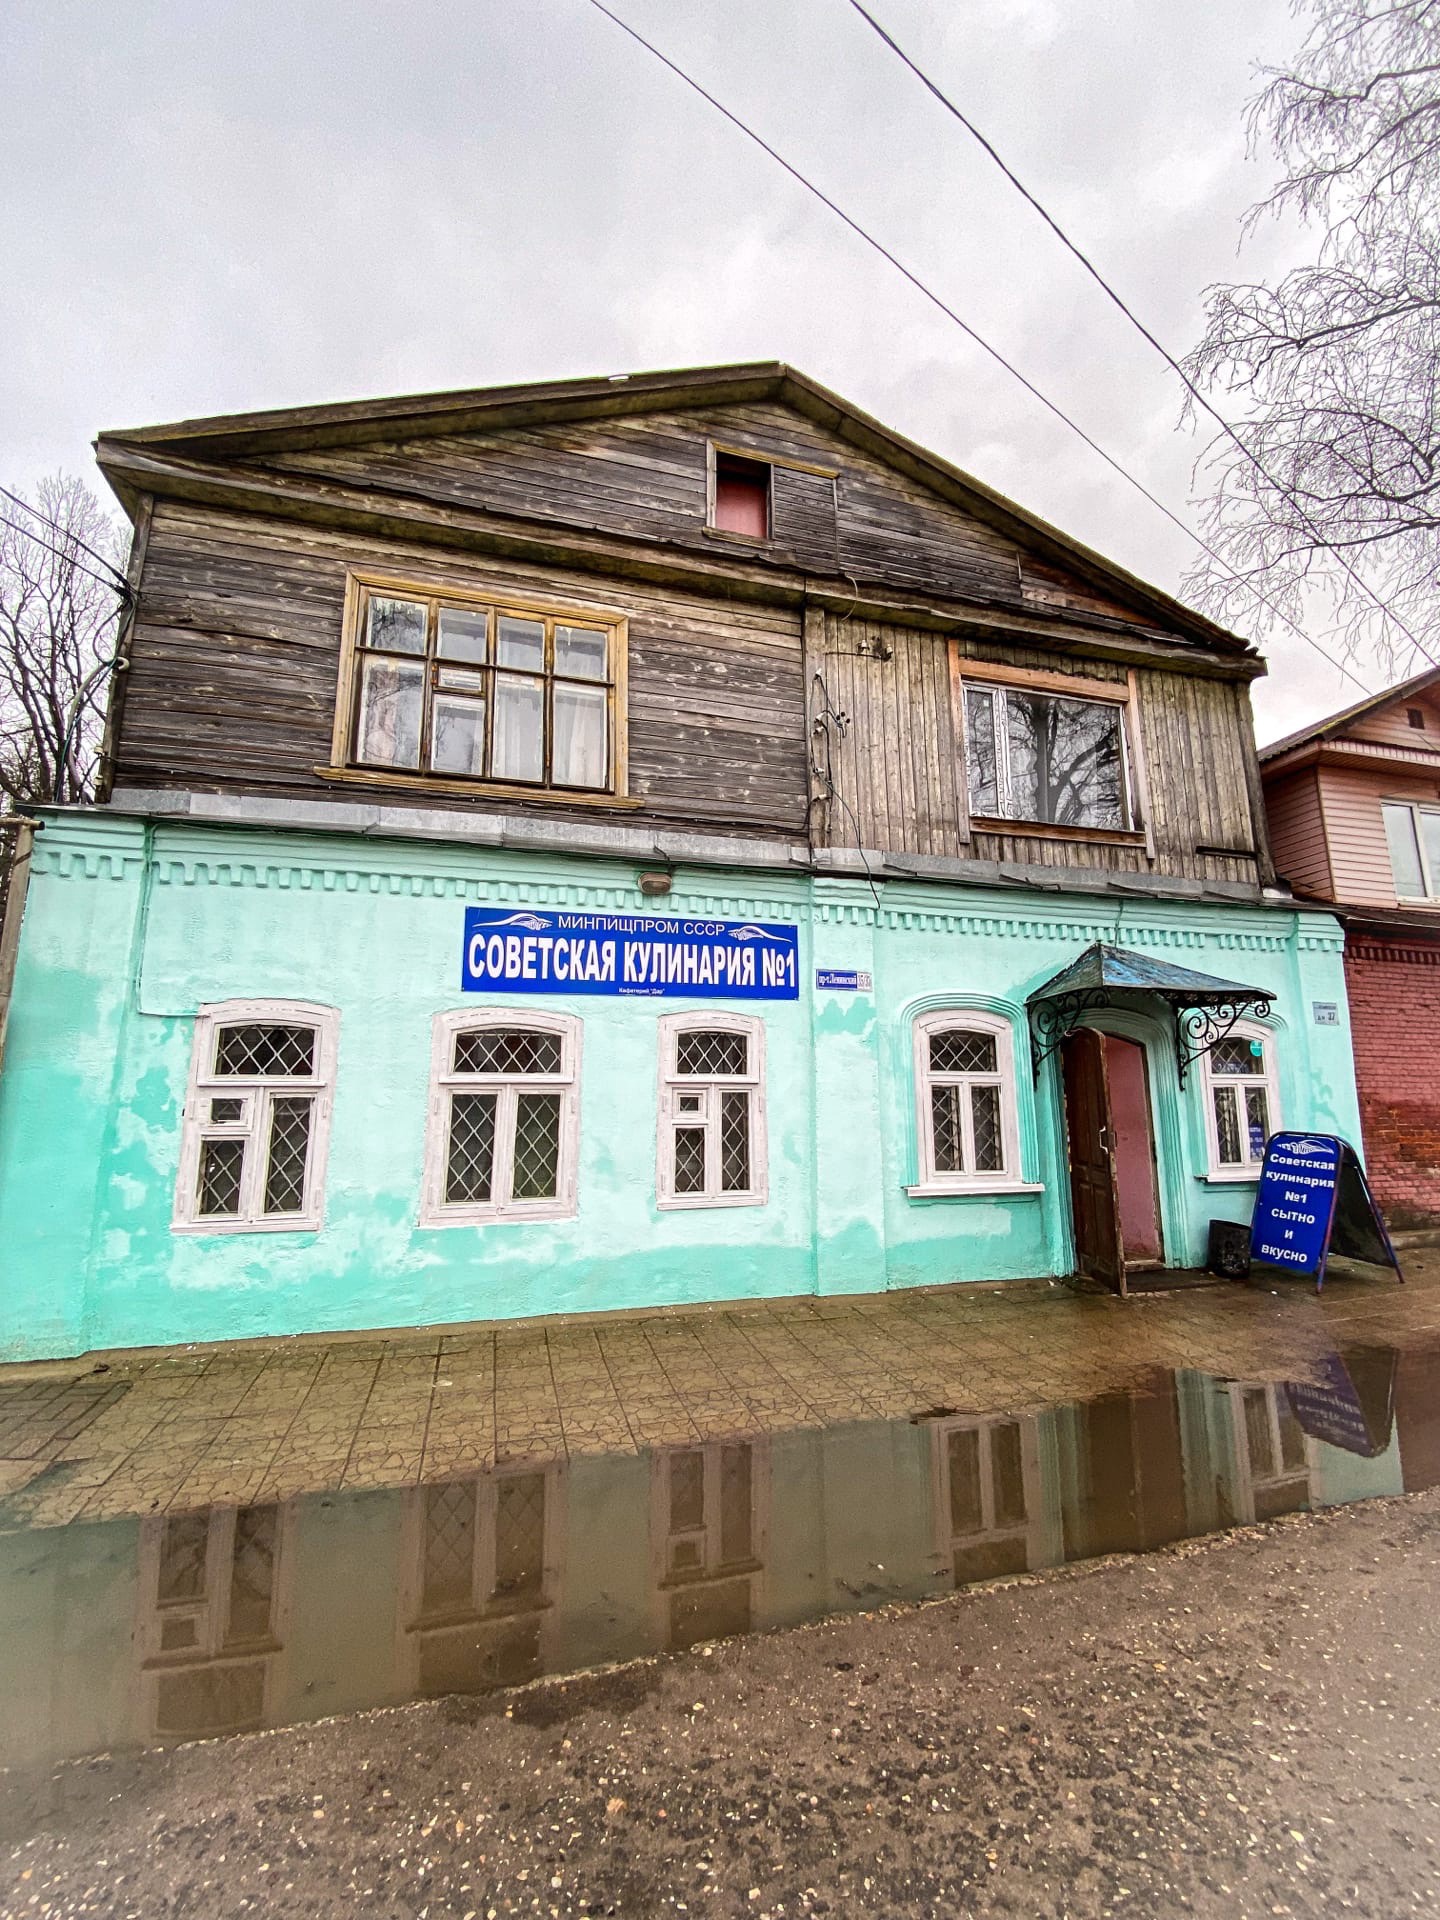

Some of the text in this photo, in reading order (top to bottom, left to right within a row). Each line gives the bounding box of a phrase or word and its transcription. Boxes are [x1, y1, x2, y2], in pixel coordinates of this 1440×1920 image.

[558, 915, 725, 936] МИНПИЩПРОМ СССР
[469, 934, 795, 987] СОВЕТСКАЯ КУЛИНАРИЯ №1
[1269, 1153, 1335, 1171] Советская
[1265, 1170, 1335, 1188] кулинария
[1285, 1191, 1307, 1203] №1
